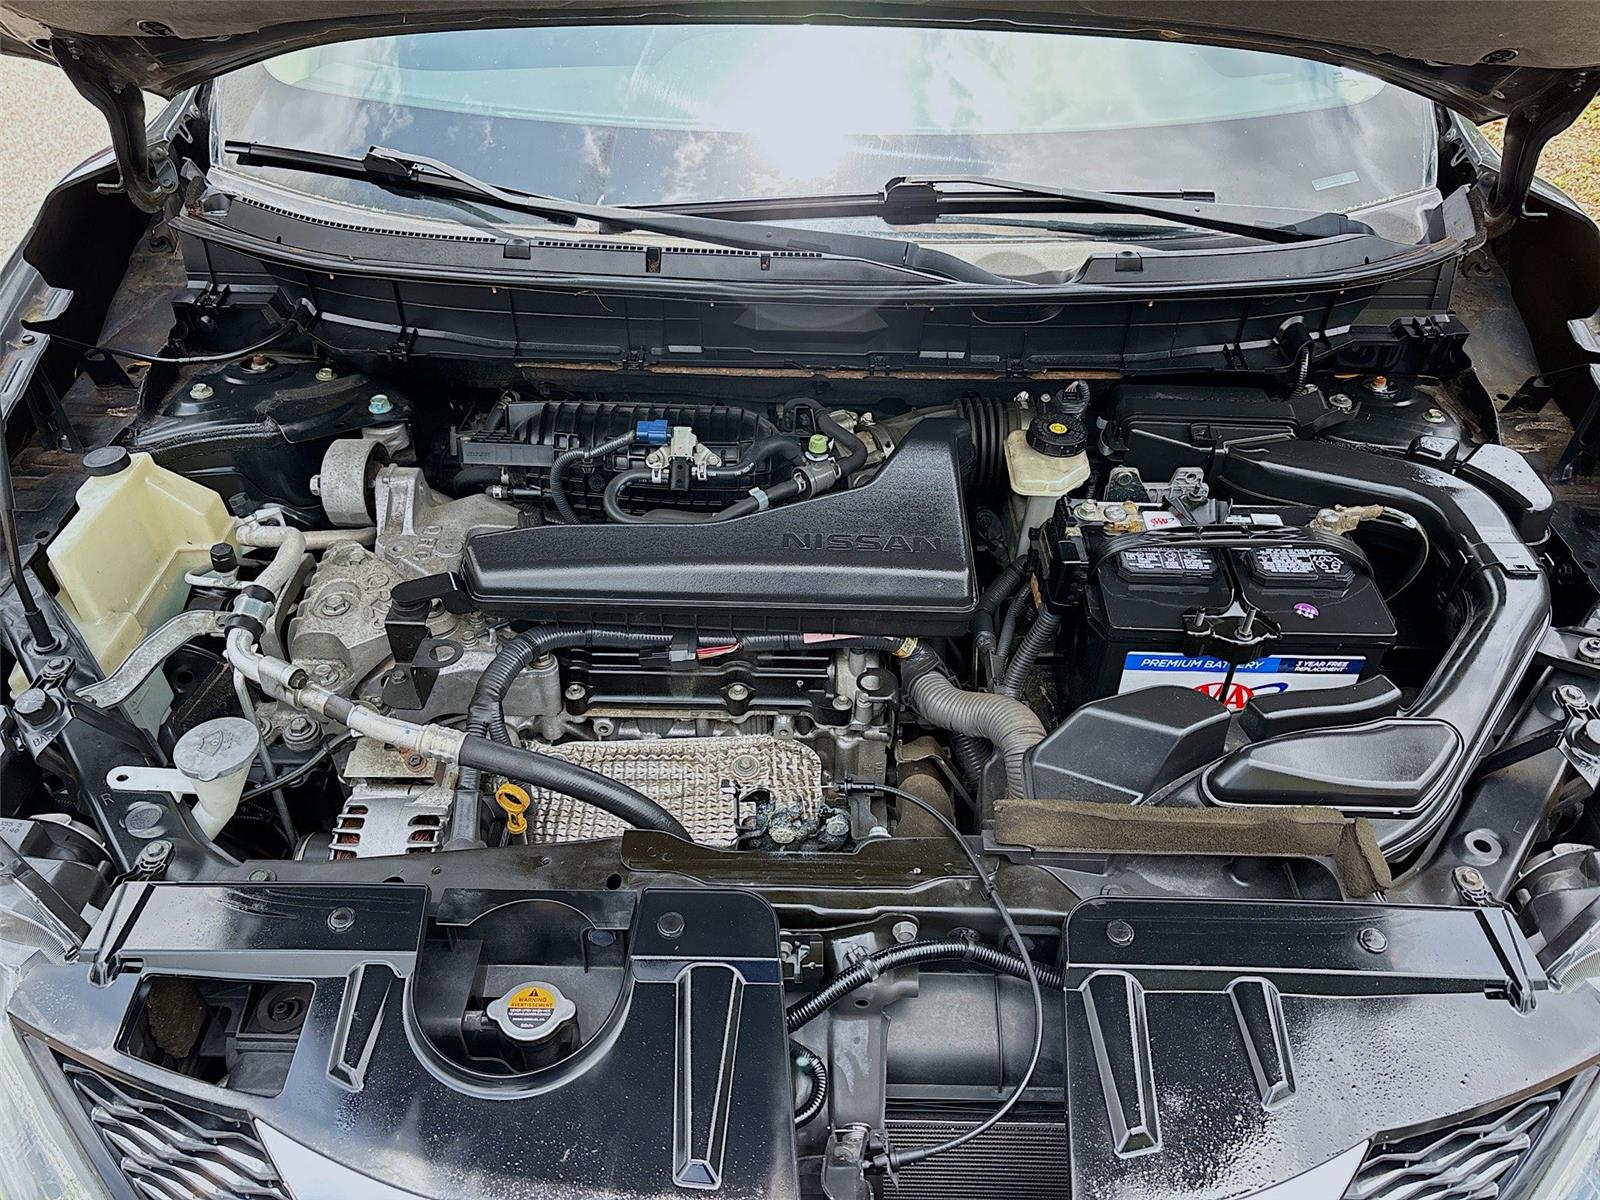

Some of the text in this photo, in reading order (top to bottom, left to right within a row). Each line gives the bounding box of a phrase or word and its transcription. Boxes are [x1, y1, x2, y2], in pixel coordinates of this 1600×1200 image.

[782, 532, 942, 553] NISSAN
[1140, 658, 1202, 669] PREMIUM
[1304, 660, 1326, 668] YEAR
[100, 792, 115, 806] R
